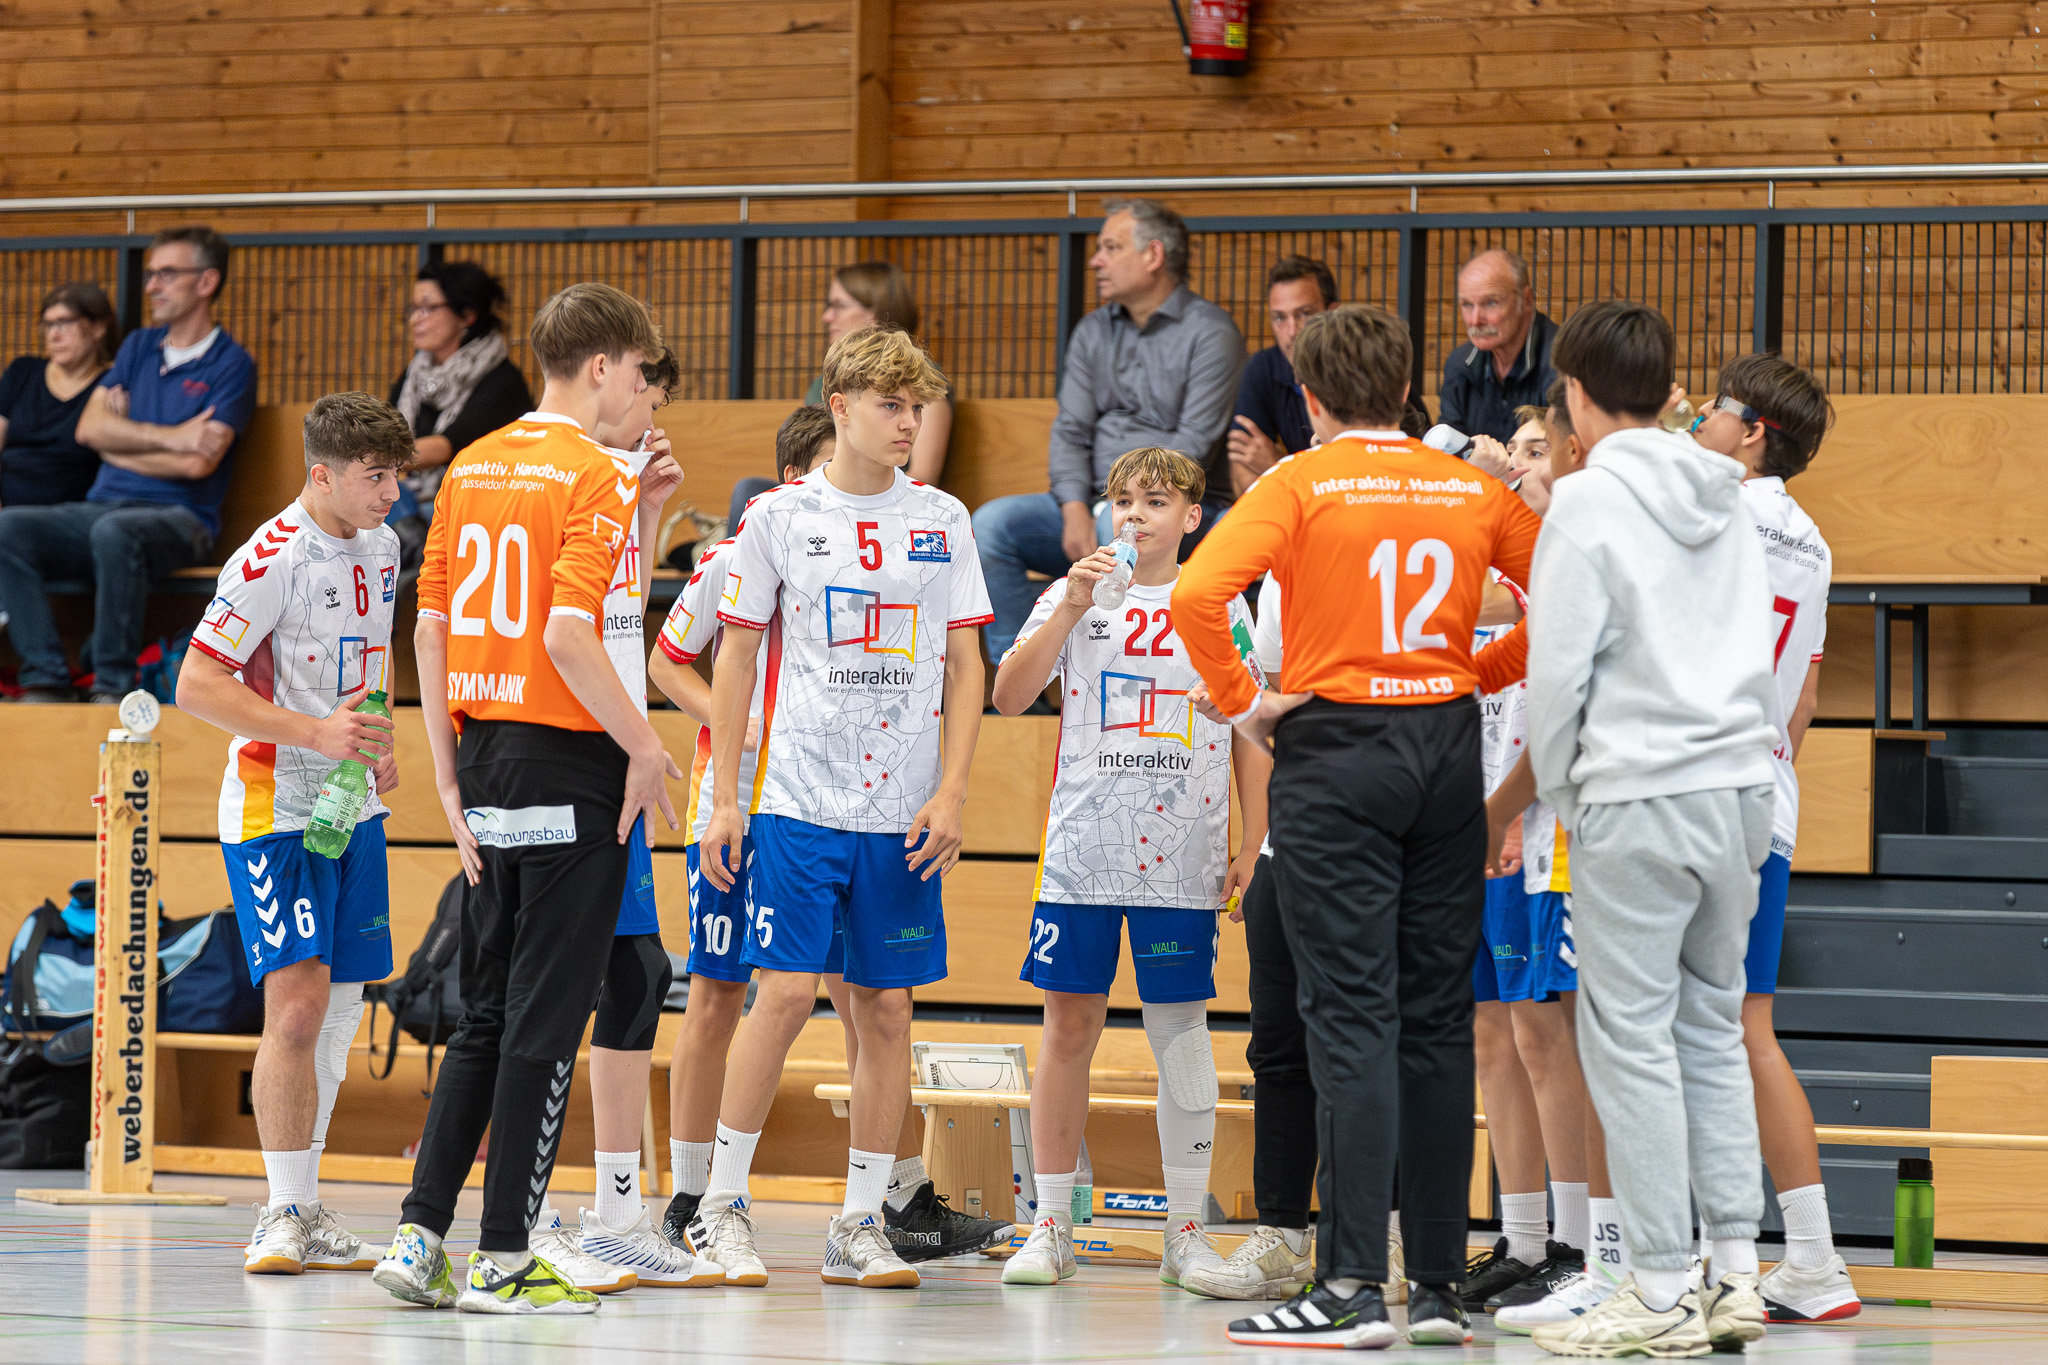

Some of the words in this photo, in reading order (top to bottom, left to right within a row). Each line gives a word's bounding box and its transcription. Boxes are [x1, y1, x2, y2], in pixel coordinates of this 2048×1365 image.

[513, 462, 577, 486] Handball
[856, 521, 882, 571] 5
[353, 564, 369, 617] 6
[450, 523, 529, 639] 20
[1368, 538, 1455, 654] 12
[1089, 633, 1111, 641] hummel
[1124, 608, 1176, 656] 22
[447, 671, 527, 704] SYMMANK
[828, 666, 914, 685] interaktiv
[1098, 751, 1191, 770] interaktiv
[293, 897, 316, 939] 6
[702, 913, 732, 956] 10
[756, 906, 774, 949] 5
[900, 926, 925, 939] WALD
[1034, 917, 1060, 965] 22
[1151, 941, 1178, 954] WALD
[118, 769, 153, 1164] weberbedachungen.de
[1595, 1222, 1620, 1242] JS
